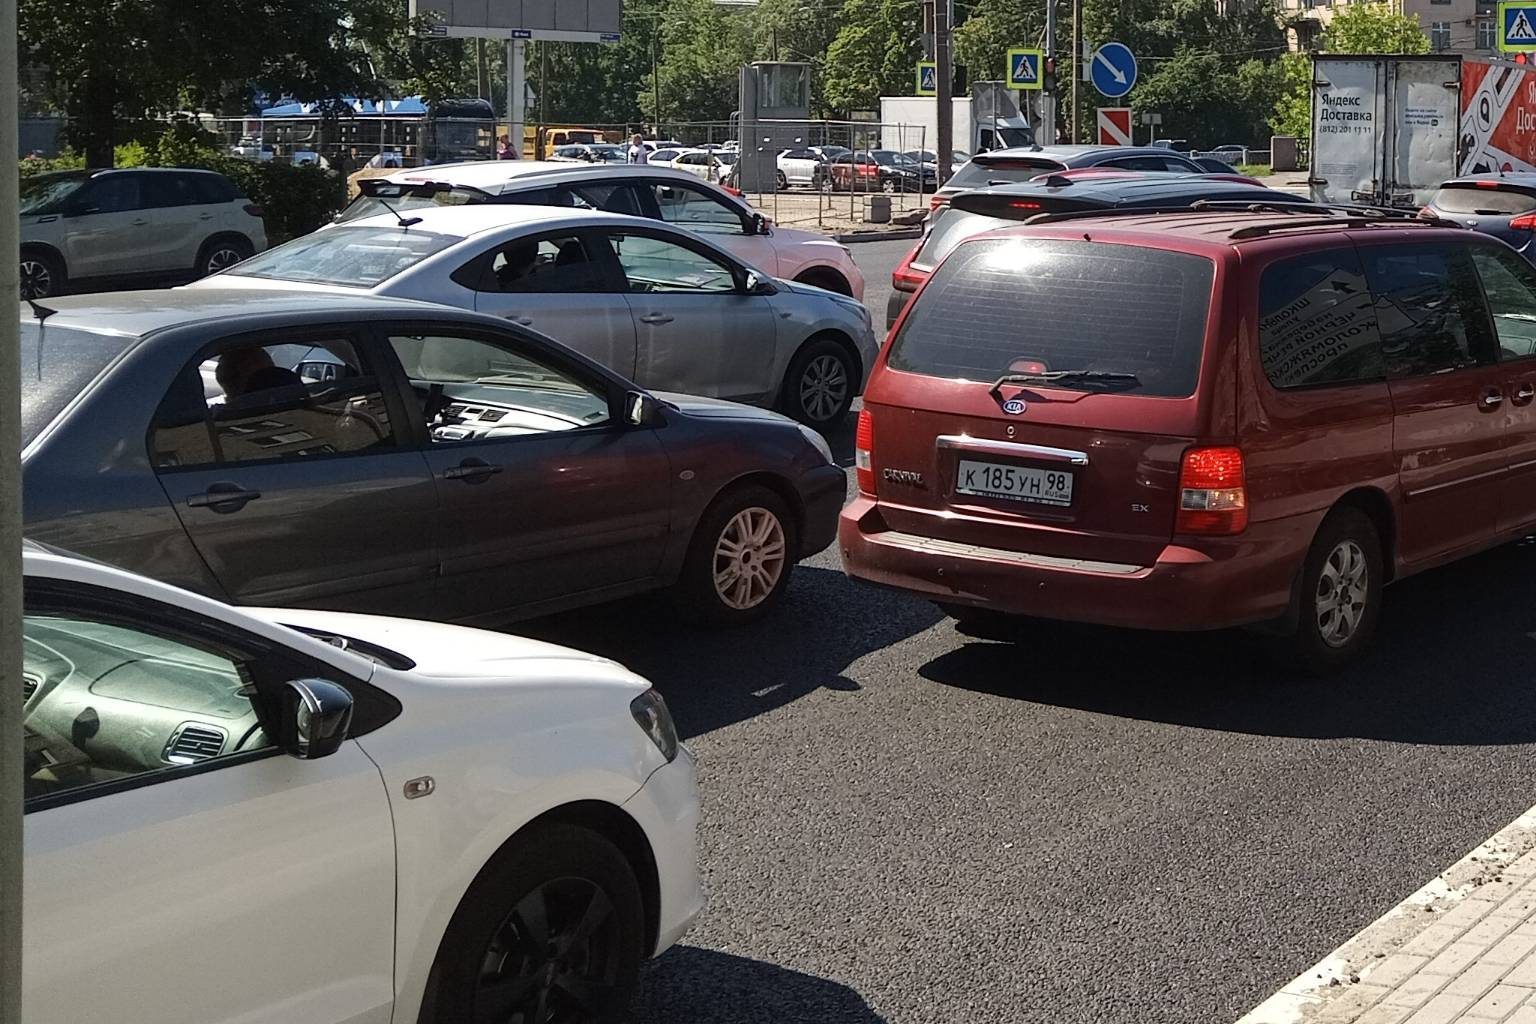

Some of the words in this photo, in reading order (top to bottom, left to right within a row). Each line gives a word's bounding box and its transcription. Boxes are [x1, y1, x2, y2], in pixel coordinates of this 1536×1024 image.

[1321, 94, 1360, 107] Яндекс
[1320, 108, 1372, 122] Доставка
[1319, 125, 1338, 134] (812)
[1006, 402, 1023, 411] KIA
[1047, 473, 1066, 491] 98
